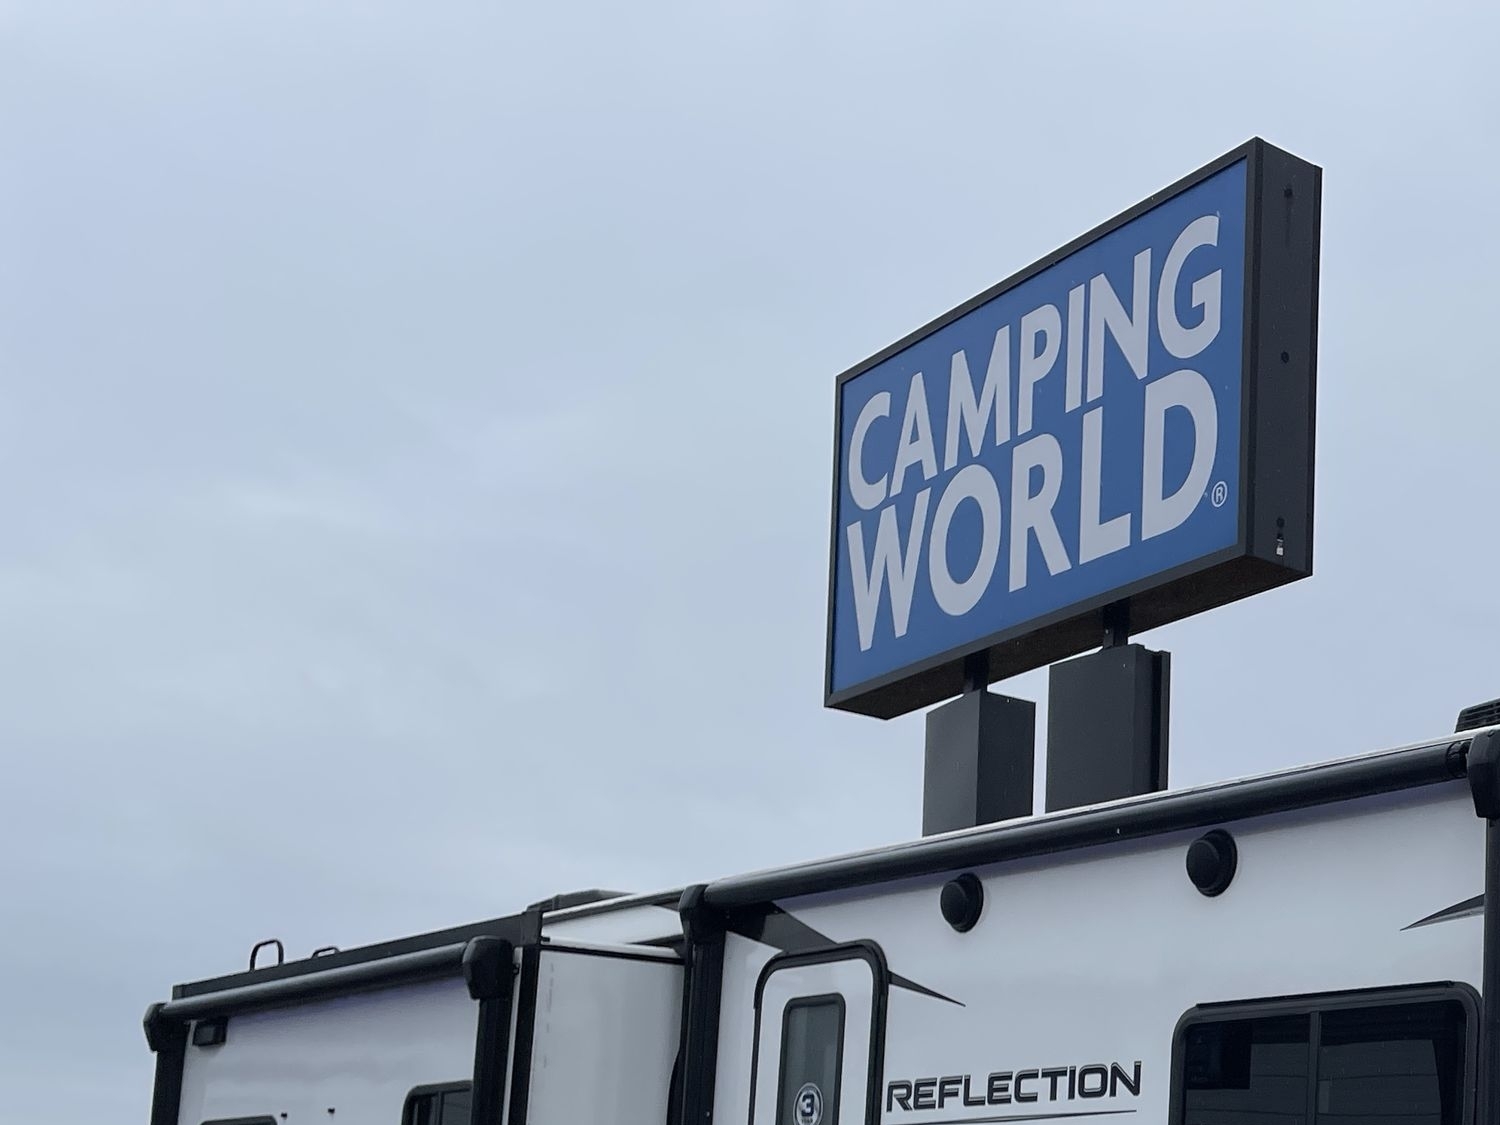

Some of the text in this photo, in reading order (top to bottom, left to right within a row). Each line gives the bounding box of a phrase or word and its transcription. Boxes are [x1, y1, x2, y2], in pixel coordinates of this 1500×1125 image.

[848, 214, 1222, 510] CAMPING
[846, 368, 1218, 652] WORLD
[801, 1093, 815, 1117] 3
[886, 1061, 1142, 1113] REFLECTION
